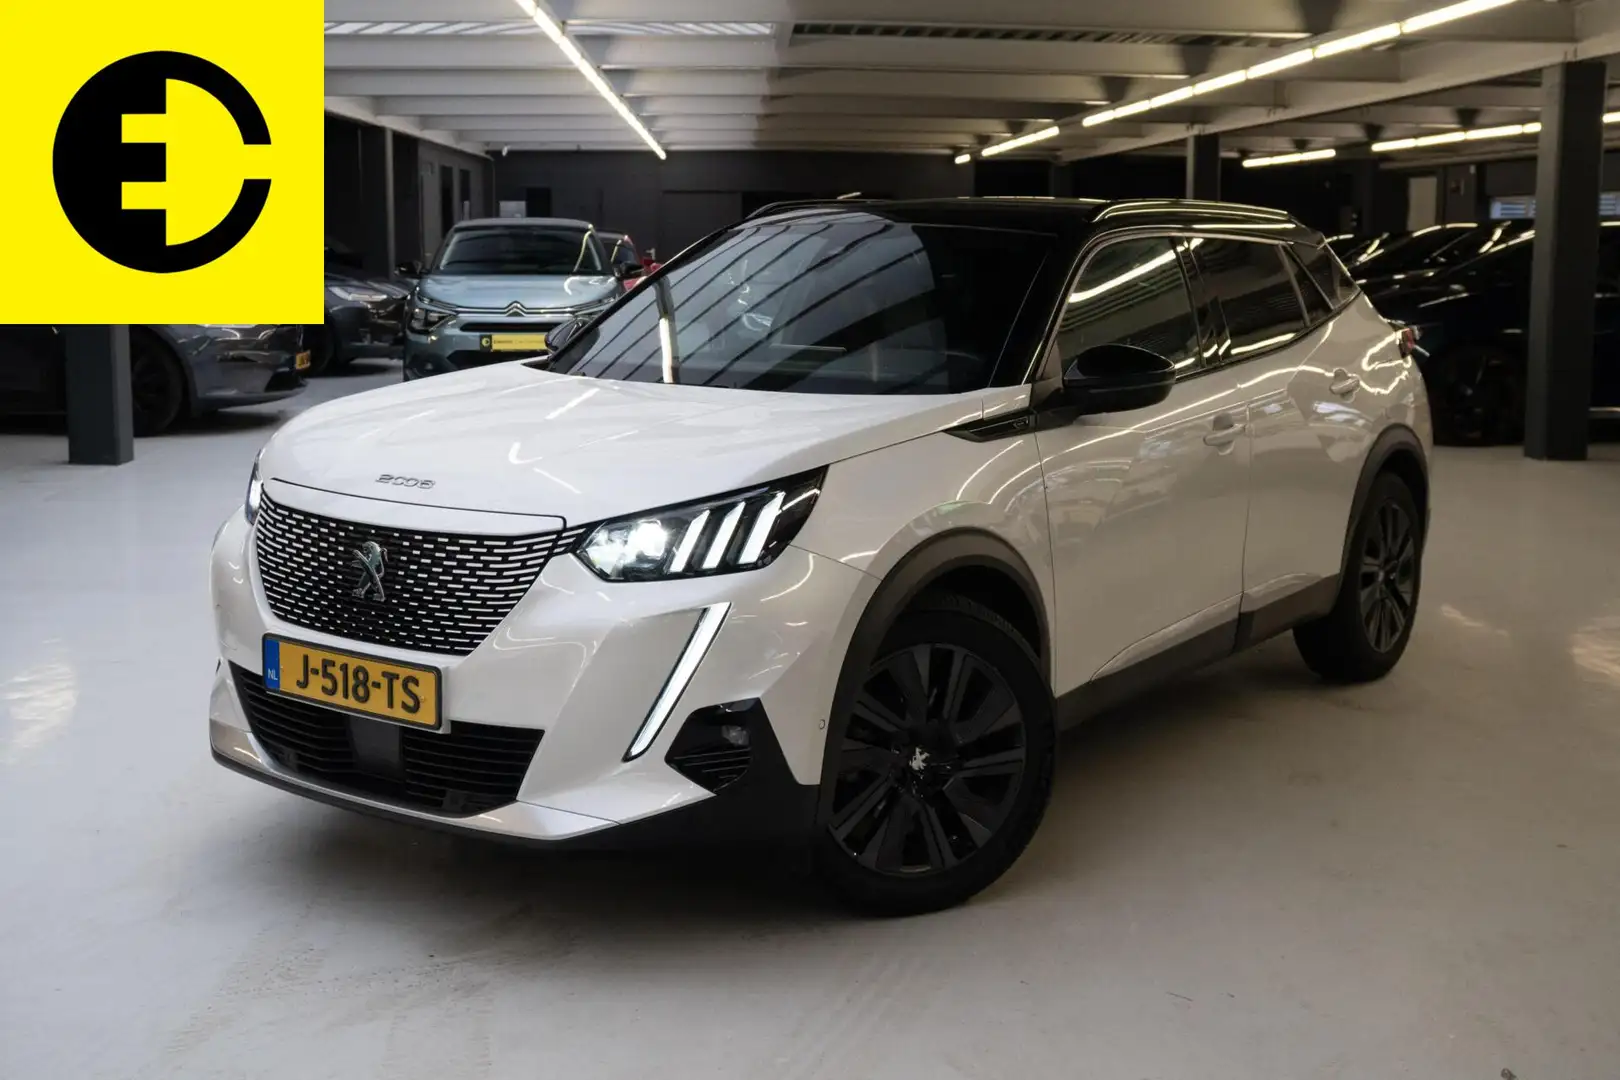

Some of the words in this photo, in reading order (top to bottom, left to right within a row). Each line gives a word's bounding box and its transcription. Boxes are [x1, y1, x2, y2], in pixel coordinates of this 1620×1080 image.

[375, 474, 435, 489] 2008
[267, 668, 278, 680] NL
[296, 654, 421, 714] J-518-TS
